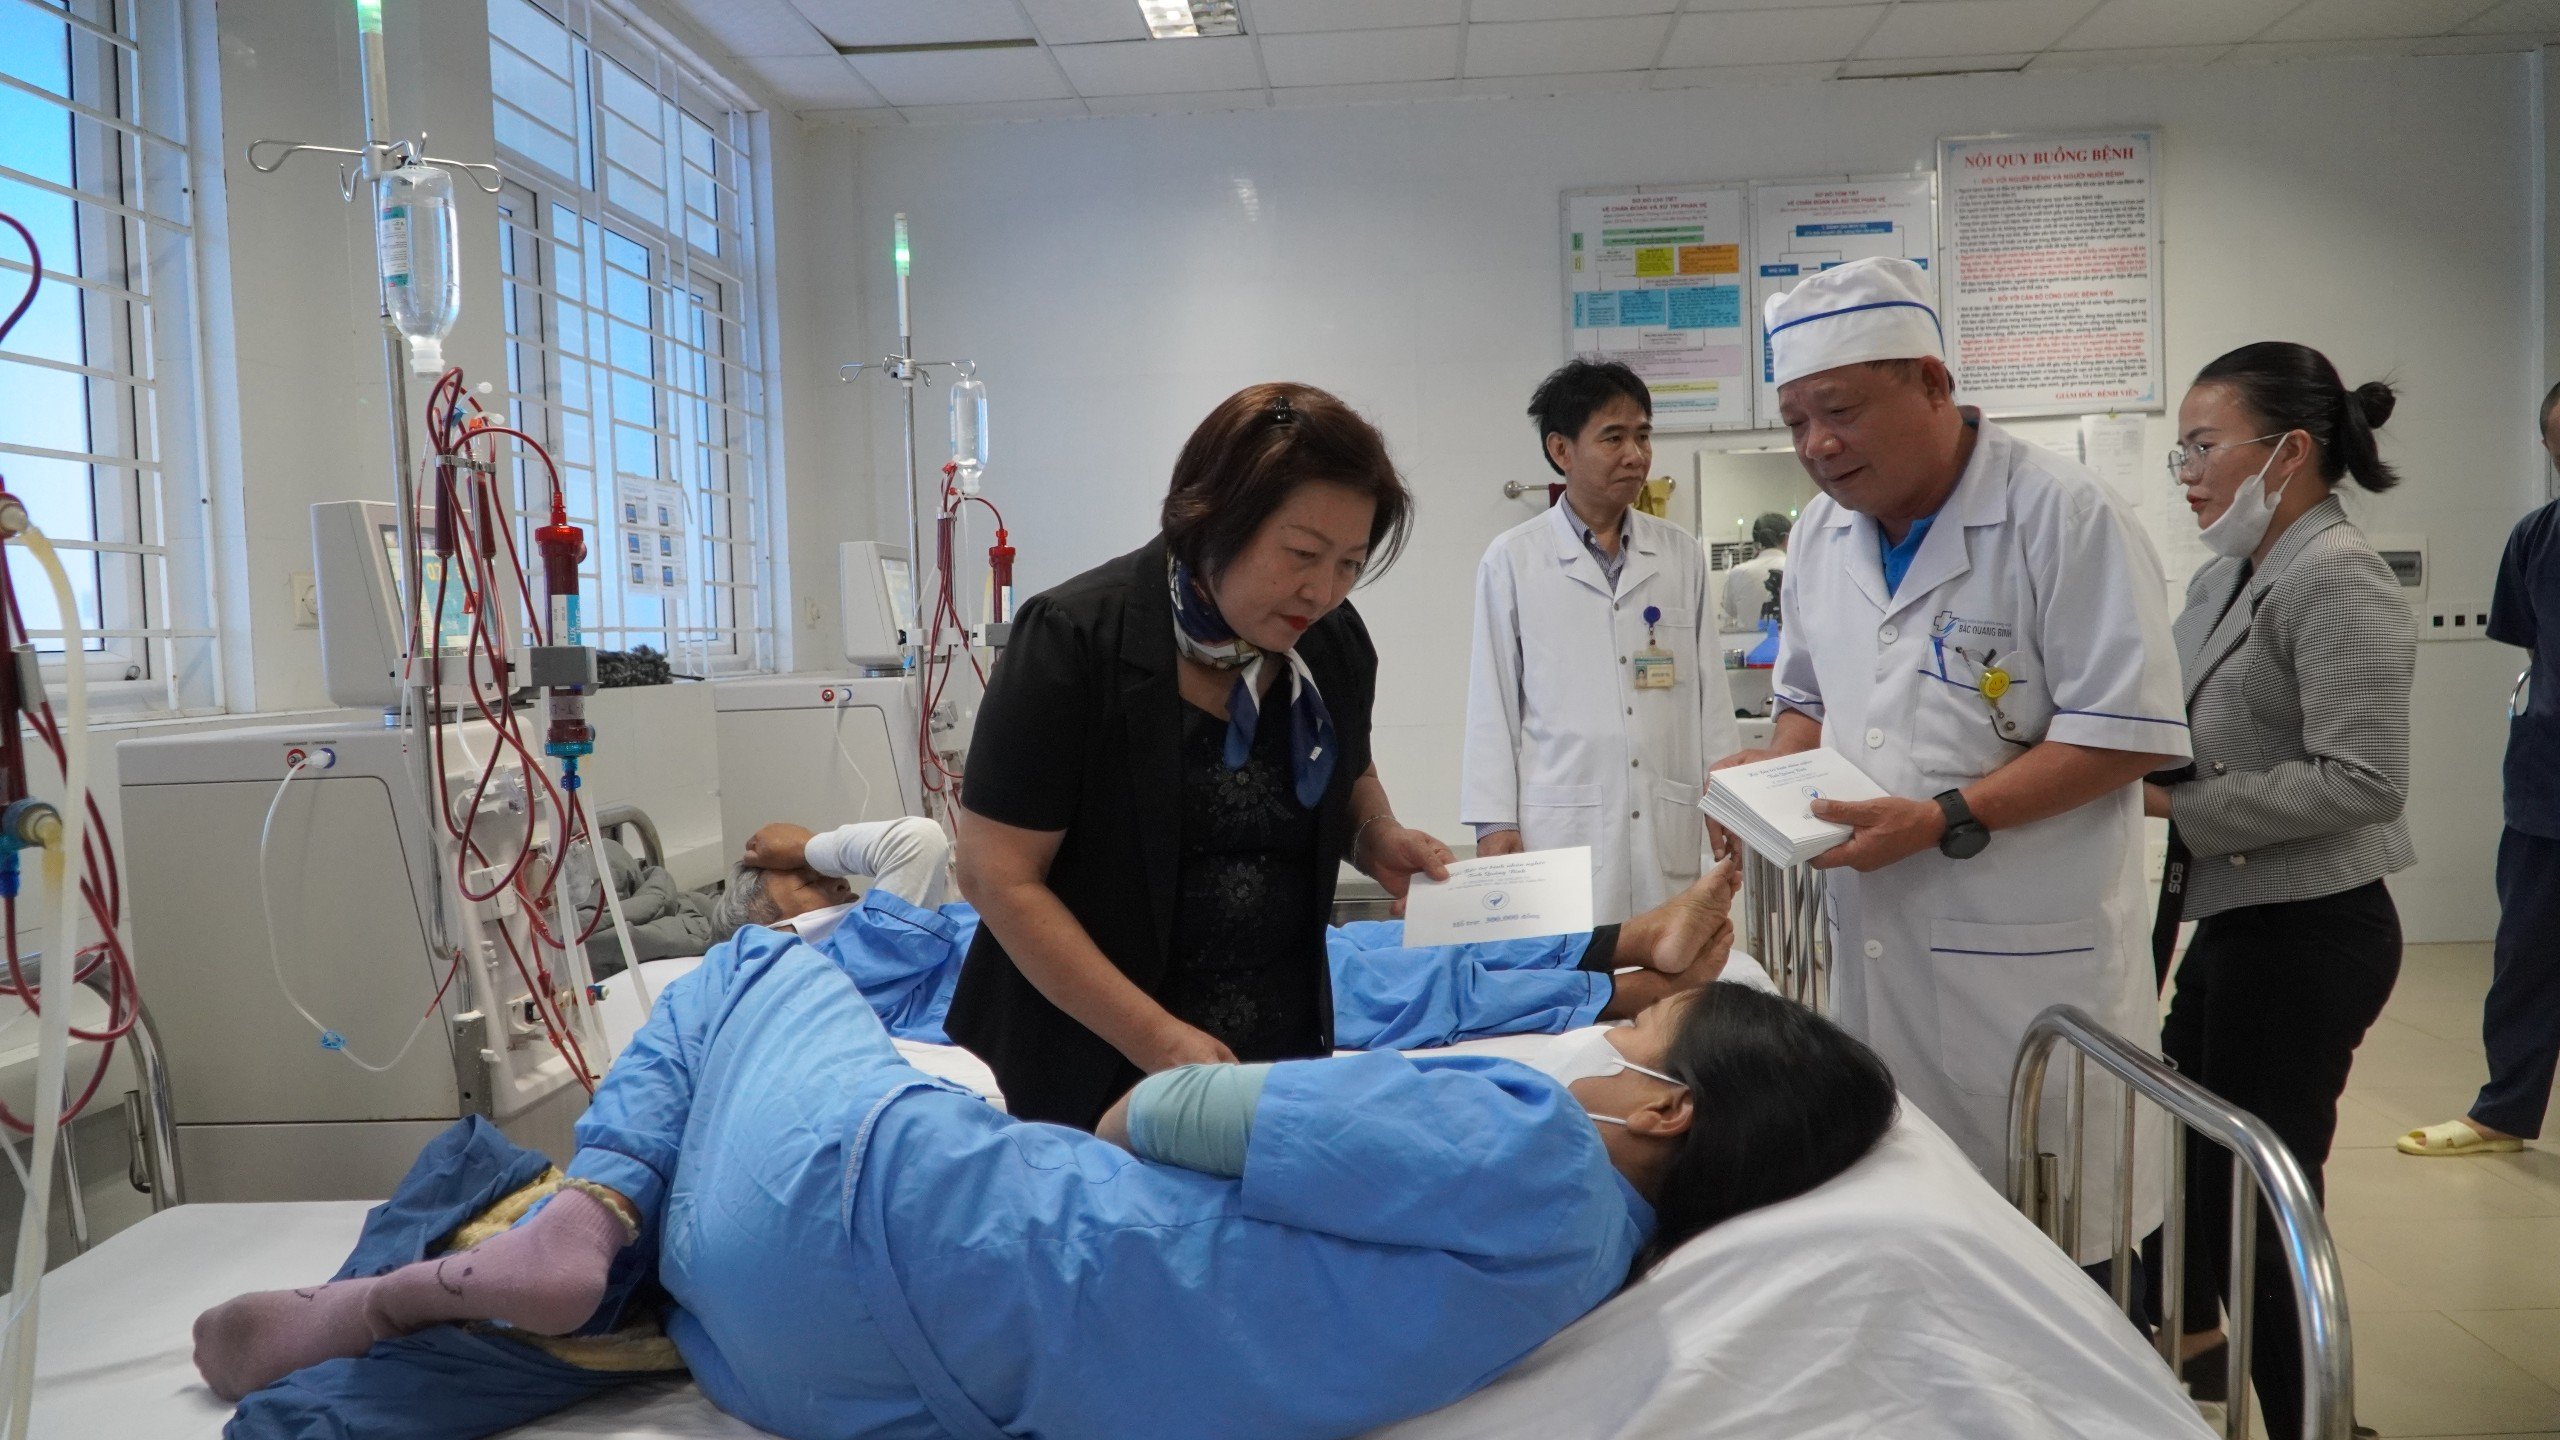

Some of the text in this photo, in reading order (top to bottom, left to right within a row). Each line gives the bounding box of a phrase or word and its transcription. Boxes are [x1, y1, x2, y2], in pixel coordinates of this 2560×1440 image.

[1964, 144, 2134, 170] NỘI QUY BUỒNG BỆNH
[2168, 862, 2184, 894] EOS
